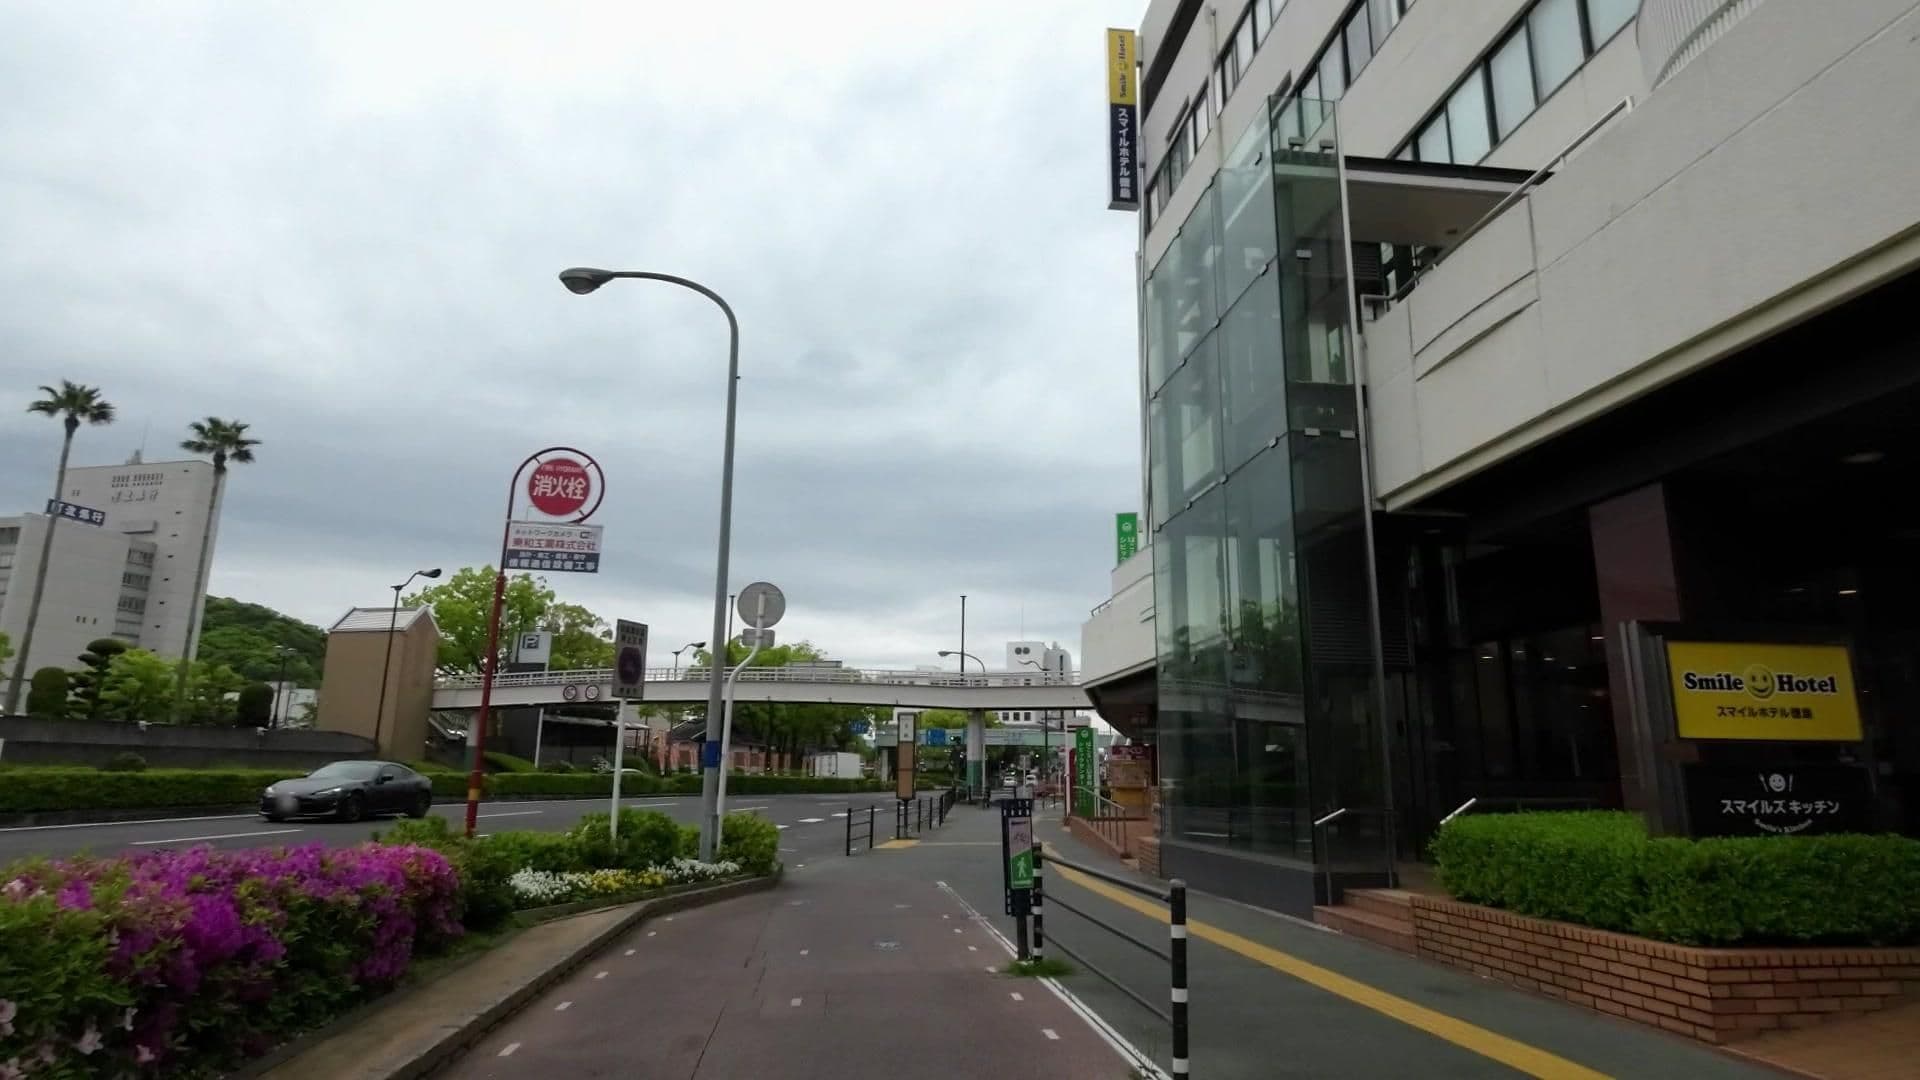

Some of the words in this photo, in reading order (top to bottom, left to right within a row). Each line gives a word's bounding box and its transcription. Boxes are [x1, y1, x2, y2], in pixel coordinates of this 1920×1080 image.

[1119, 73, 1127, 97] Smile
[533, 473, 586, 500] 消火栓
[1684, 672, 1743, 691] Smile
[1777, 674, 1837, 693] Hotel
